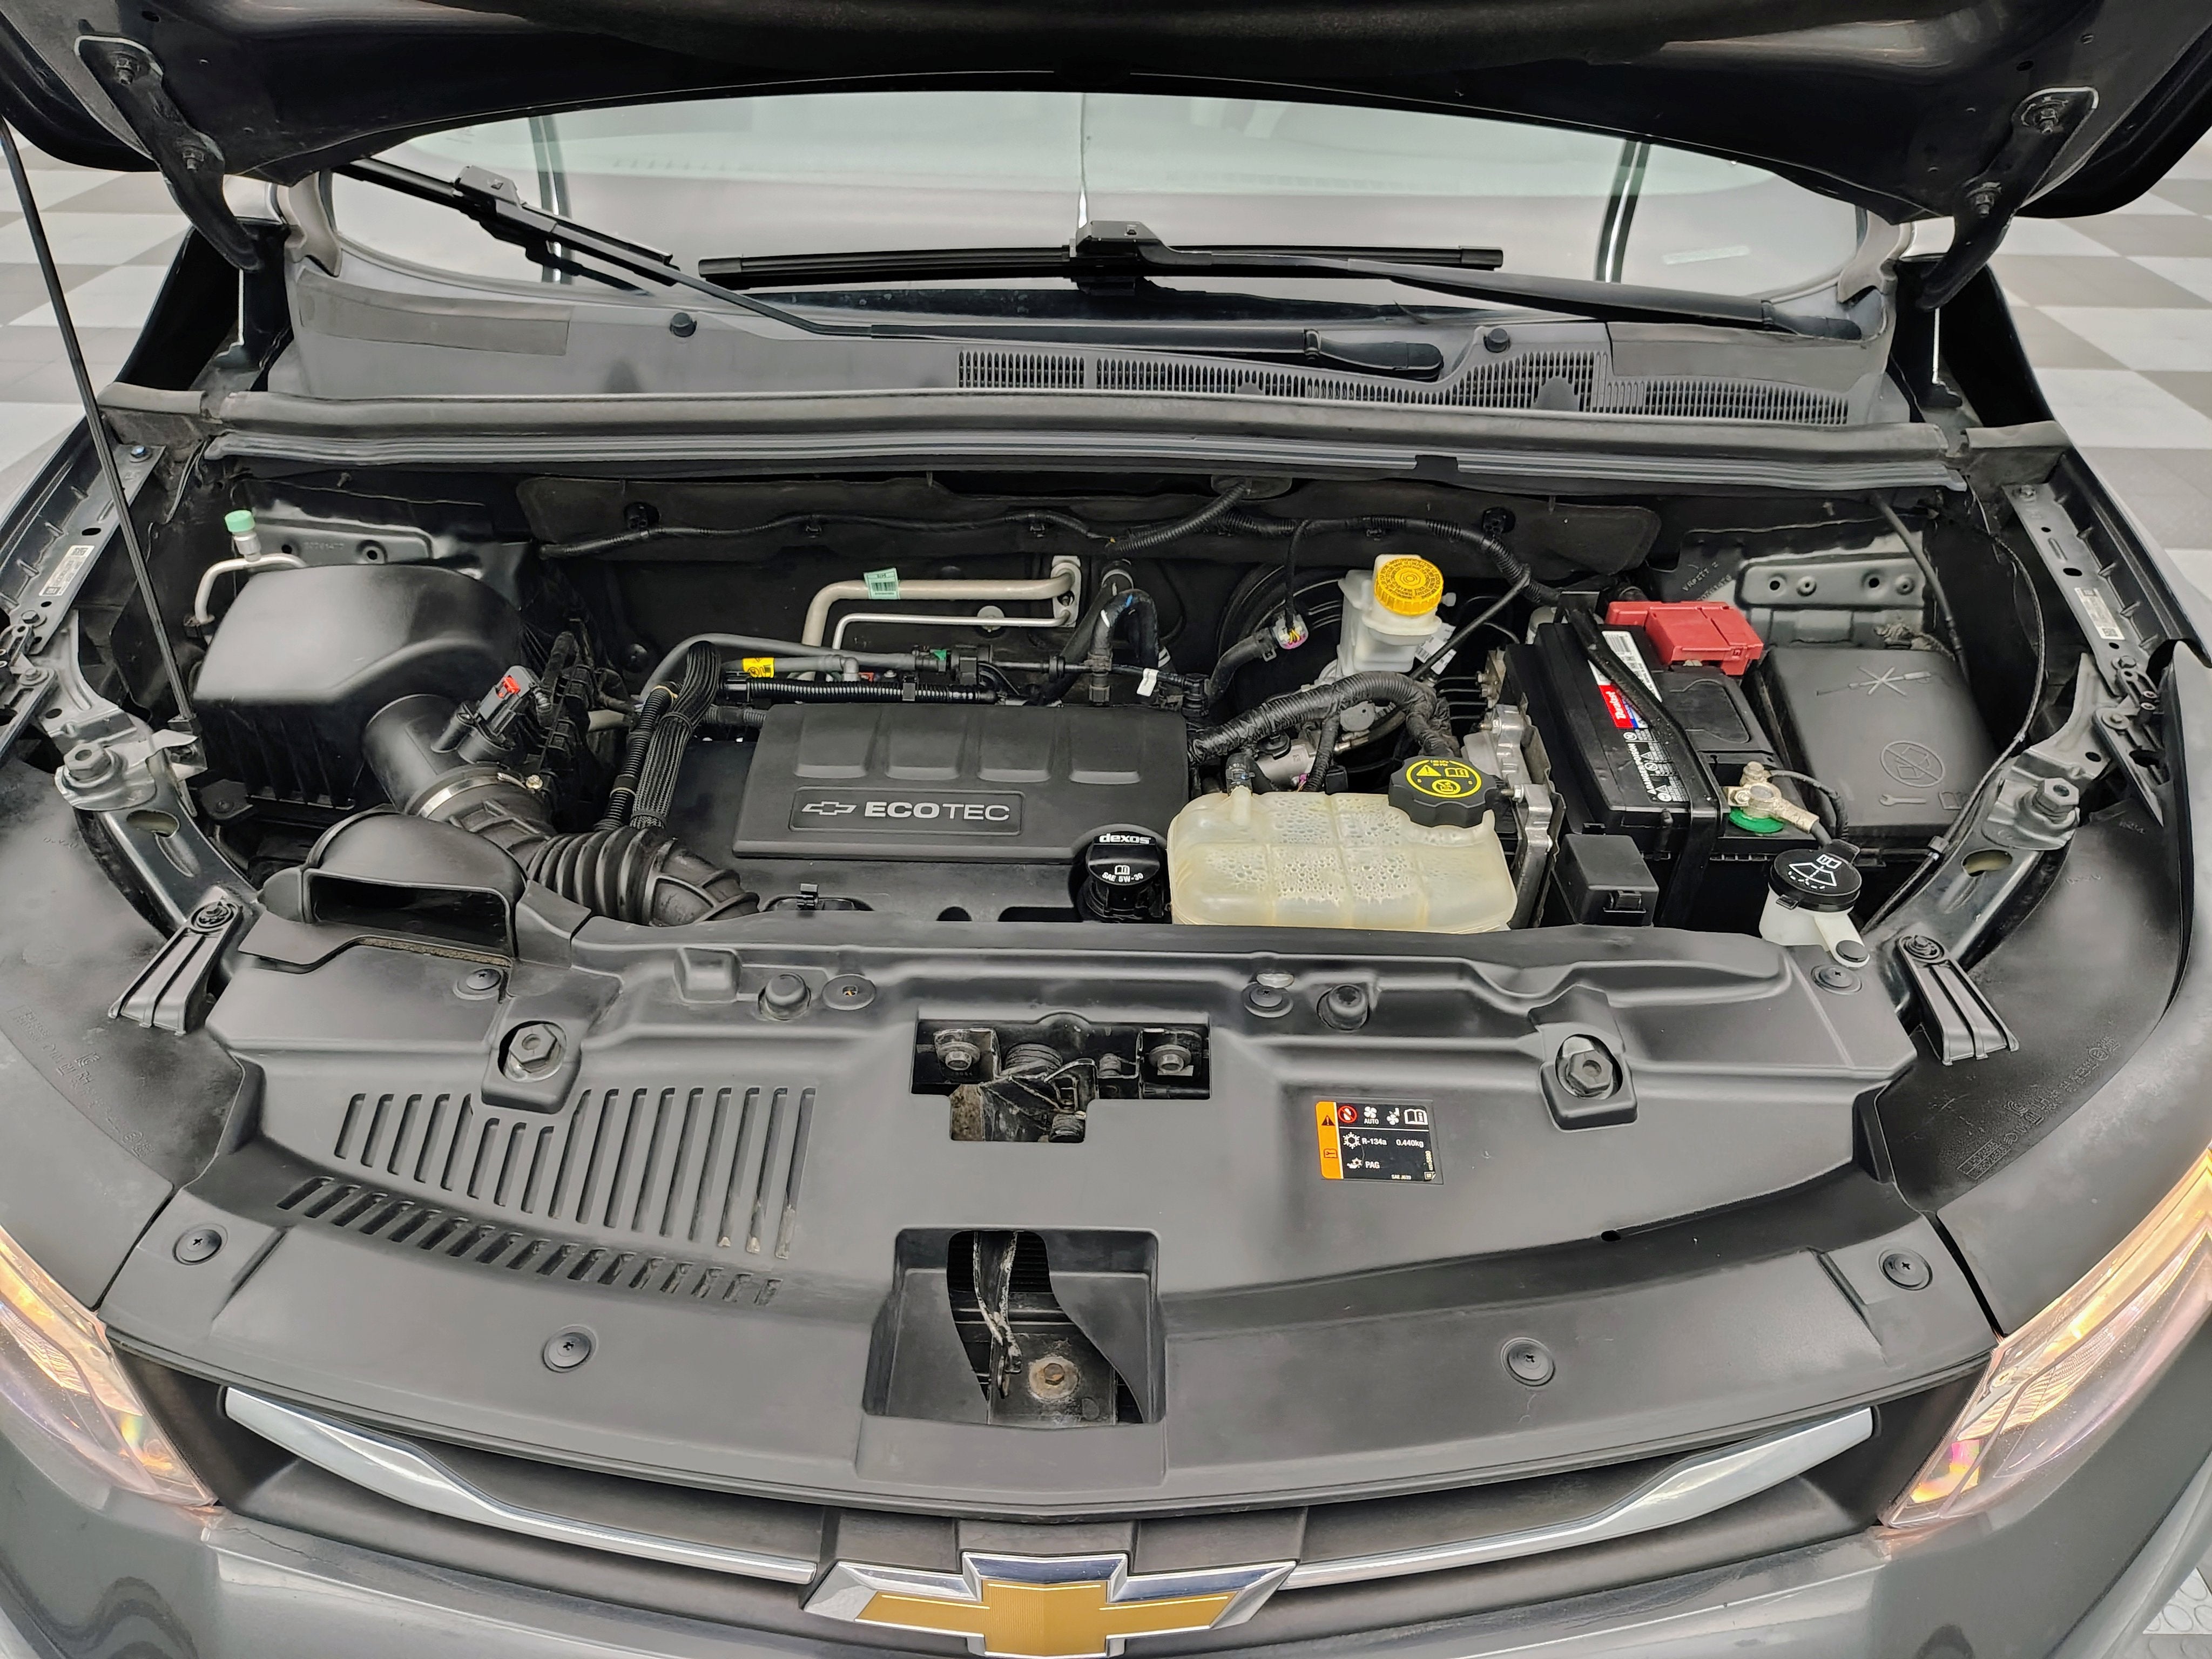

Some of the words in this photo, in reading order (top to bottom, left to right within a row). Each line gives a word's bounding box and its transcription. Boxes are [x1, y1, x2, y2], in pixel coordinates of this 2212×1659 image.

[864, 801, 1010, 821] ECOTEC
[1099, 833, 1151, 844] dexos
[1102, 872, 1116, 882] SAE
[1118, 872, 1144, 882] 5W-30
[1361, 1137, 1387, 1145] R-134a
[1396, 1139, 1424, 1148] 0.440kg
